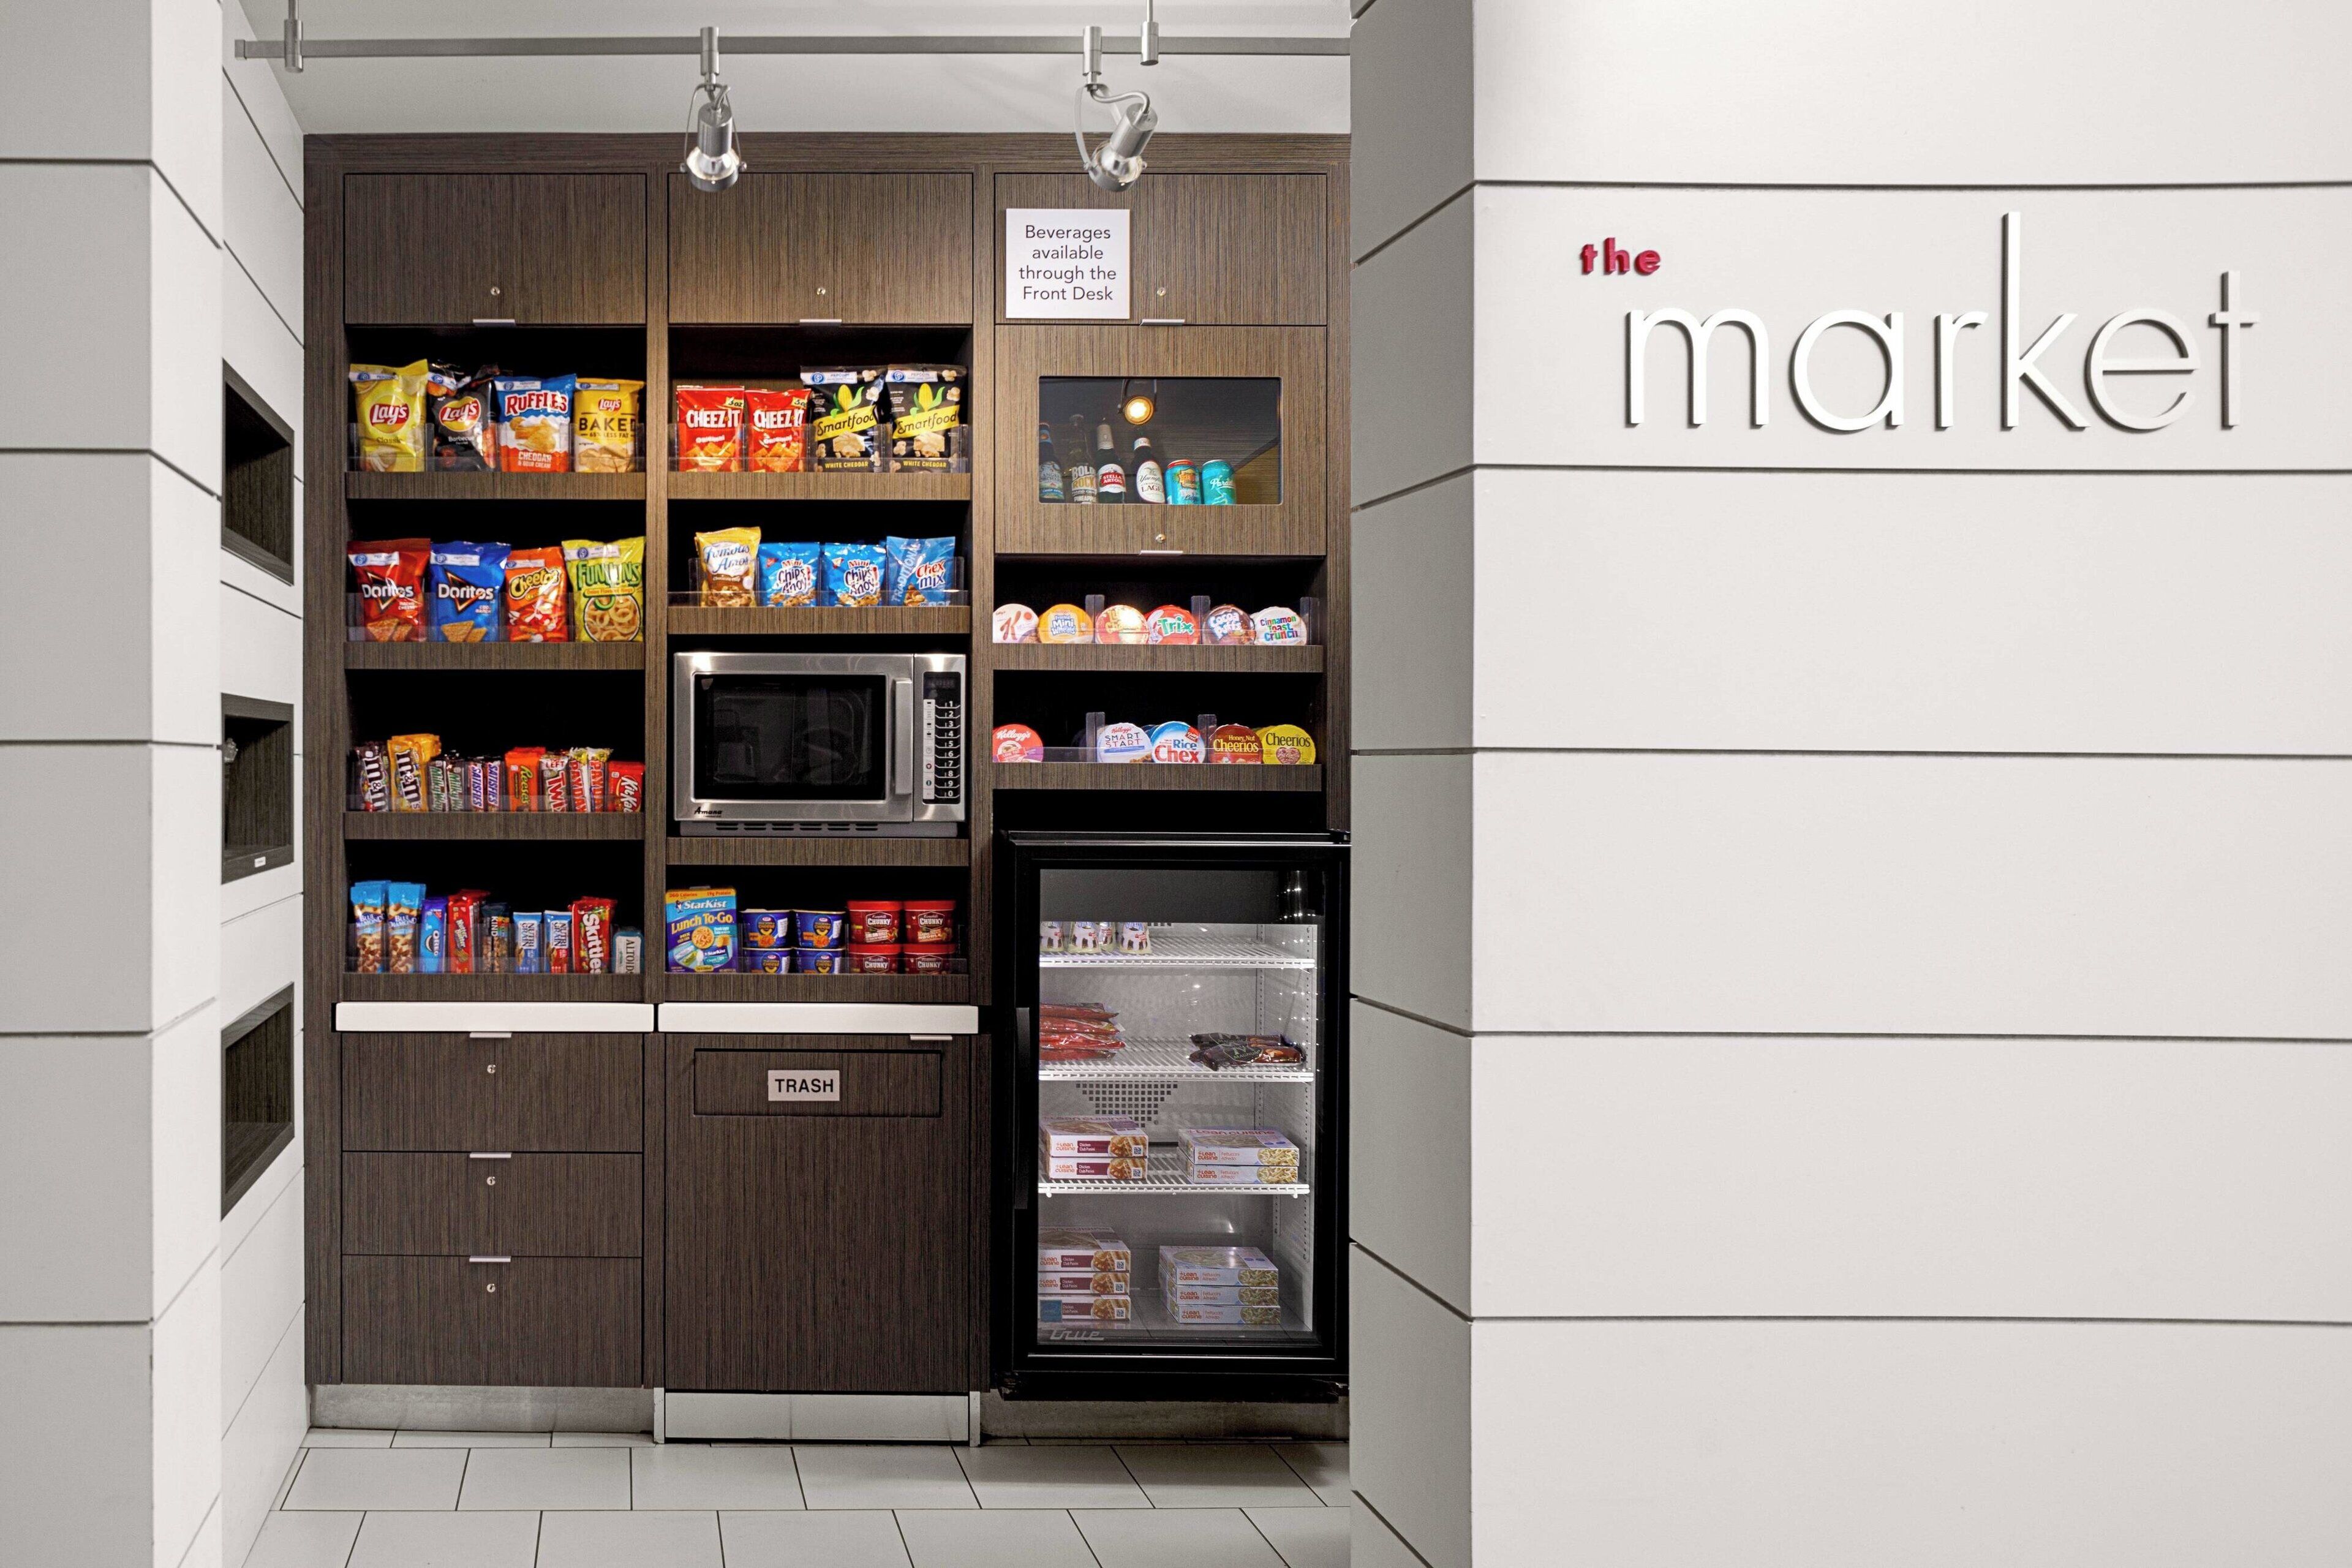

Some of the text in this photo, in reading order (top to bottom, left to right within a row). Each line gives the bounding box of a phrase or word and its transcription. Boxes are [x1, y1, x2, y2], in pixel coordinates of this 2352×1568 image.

[1025, 225, 1110, 243] Beverages
[1032, 245, 1103, 259] available
[1580, 237, 1660, 276] the
[1019, 265, 1117, 283] through the
[1023, 286, 1113, 300] Front Desk
[1624, 210, 2261, 434] market
[600, 399, 621, 411] Lay's
[371, 404, 407, 425] Lay's
[442, 403, 478, 424] Lay's
[897, 410, 956, 434] Smartfood
[916, 561, 945, 578] Chex
[361, 584, 414, 598] Doritos
[438, 583, 494, 600] Doritos
[1158, 616, 1194, 636] Trix
[1261, 616, 1296, 625] Cinnamon
[1264, 630, 1298, 641] Crunch
[1106, 733, 1140, 741] SMART
[1106, 739, 1140, 748] START
[1173, 739, 1197, 750] Rice
[1265, 733, 1311, 747] Cheerios
[1213, 739, 1259, 753] Cheerios
[1155, 745, 1199, 763] Chex
[684, 899, 727, 909] StarKist
[671, 915, 702, 935] Lunch
[582, 913, 603, 974] Skittles
[775, 1079, 834, 1093] TRASH
